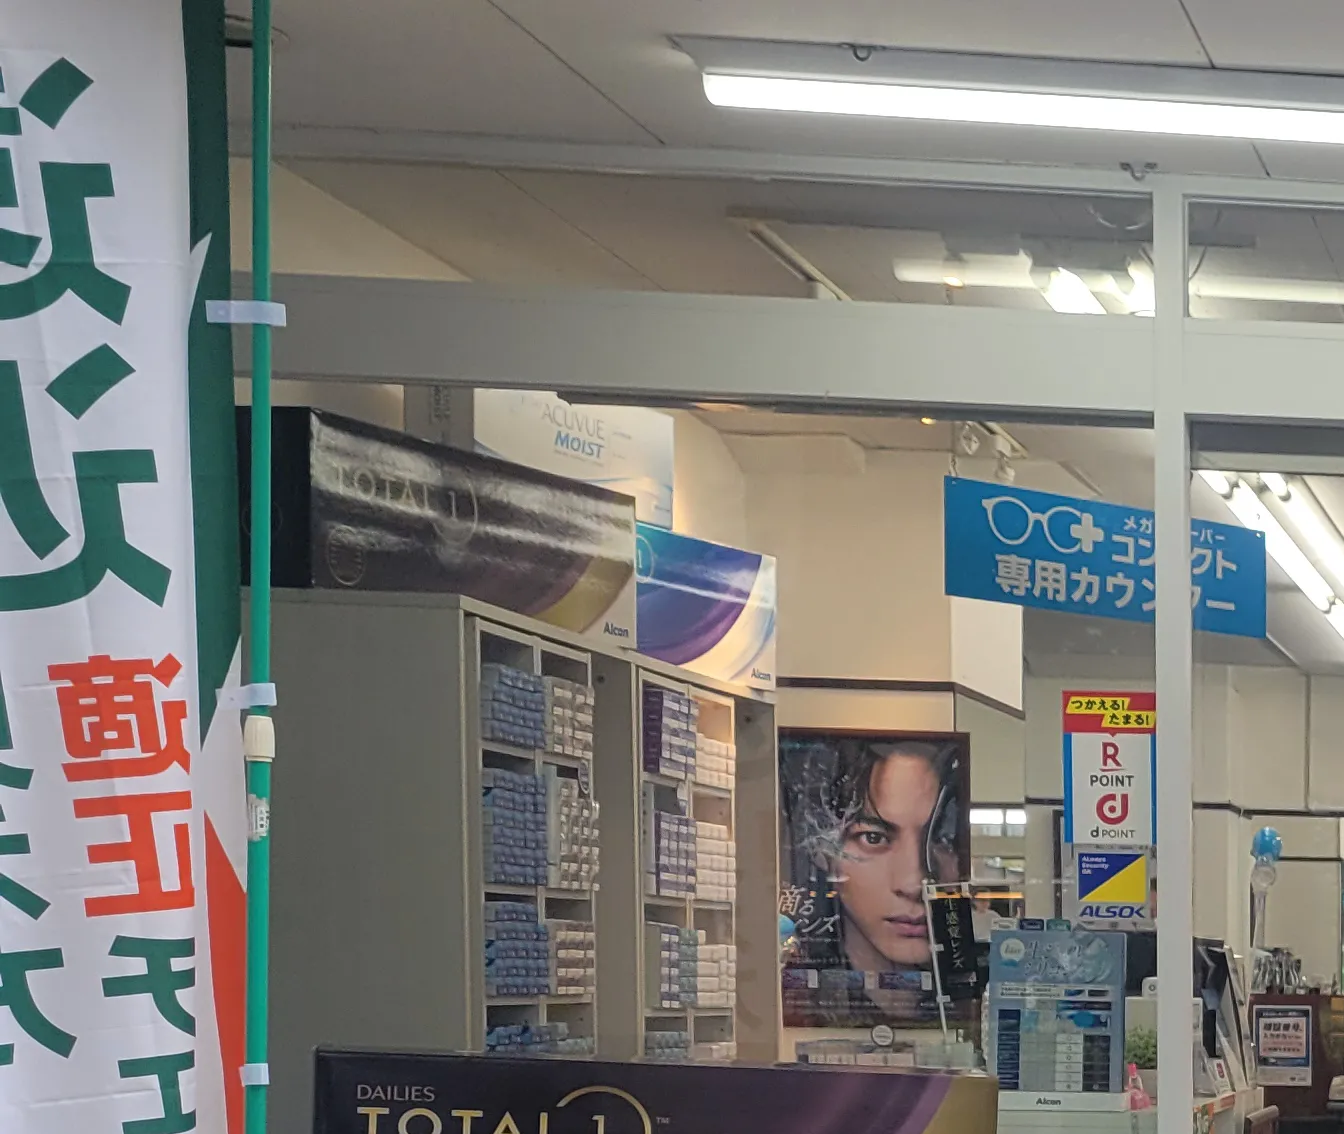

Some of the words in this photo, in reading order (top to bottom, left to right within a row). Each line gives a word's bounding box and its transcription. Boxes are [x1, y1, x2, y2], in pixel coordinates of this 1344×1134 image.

[541, 402, 606, 441] ACUVUE
[554, 430, 605, 459] MOIST
[1123, 515, 1226, 543] メガーパー
[1111, 533, 1238, 580] コンクト
[603, 621, 629, 638] Alcon
[1089, 774, 1135, 788] POINT
[1101, 829, 1136, 839] POINT
[1079, 905, 1146, 919] ALSOK
[356, 1084, 436, 1102] DAILIES
